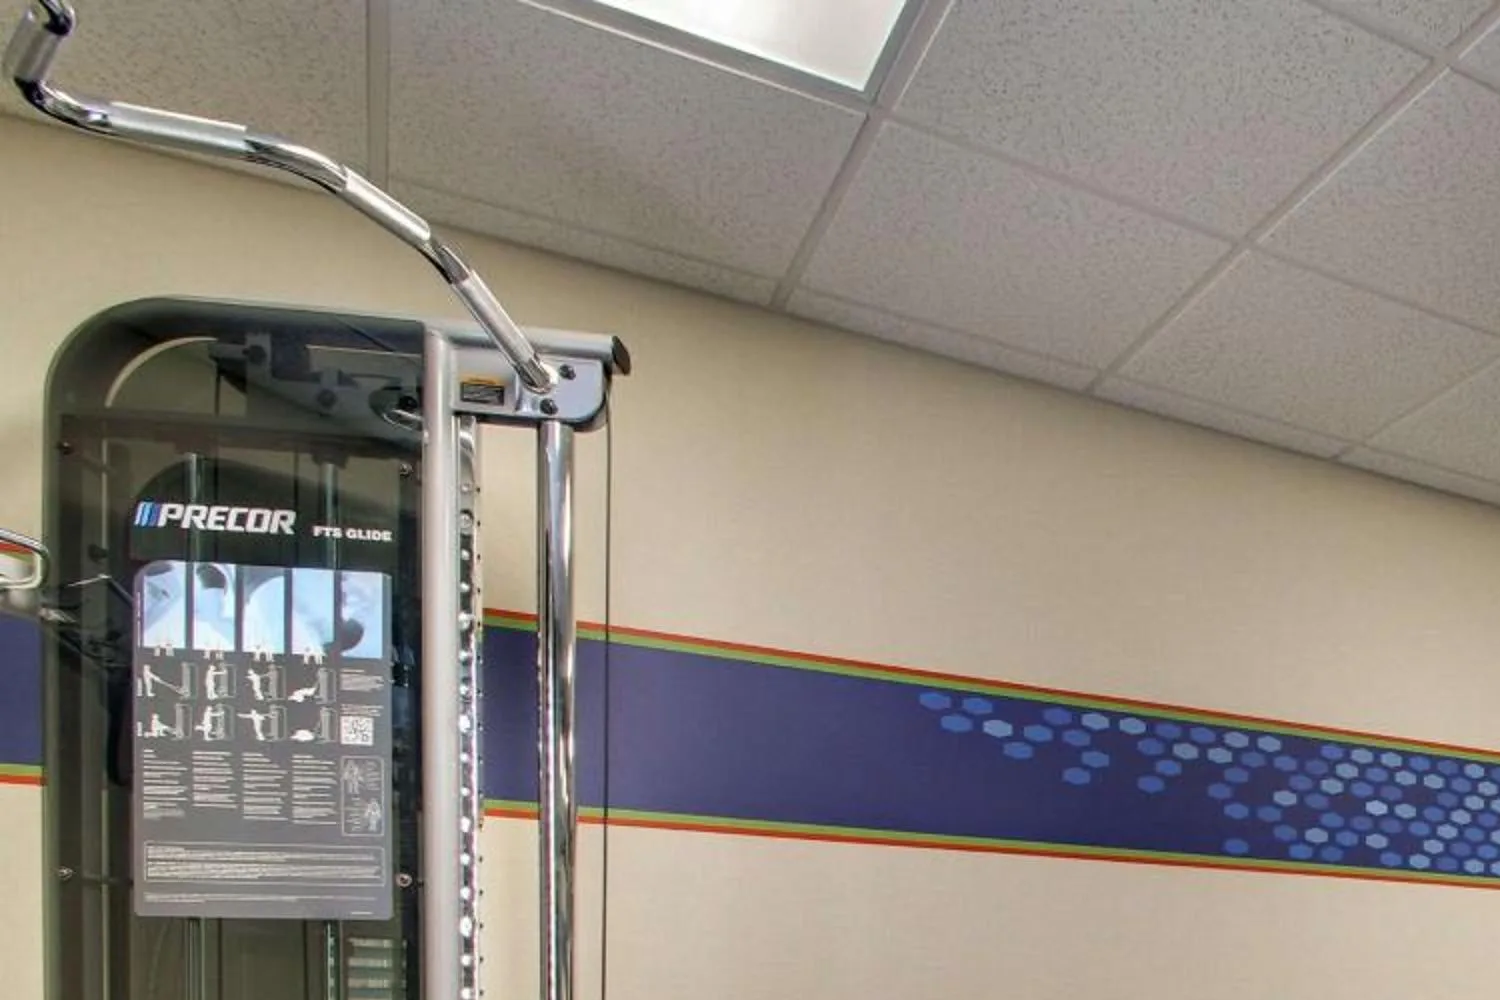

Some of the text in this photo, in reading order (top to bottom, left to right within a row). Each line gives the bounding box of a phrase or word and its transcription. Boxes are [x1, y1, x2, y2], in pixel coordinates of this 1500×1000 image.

[157, 503, 393, 541] PRECOR FTS GLIDE
